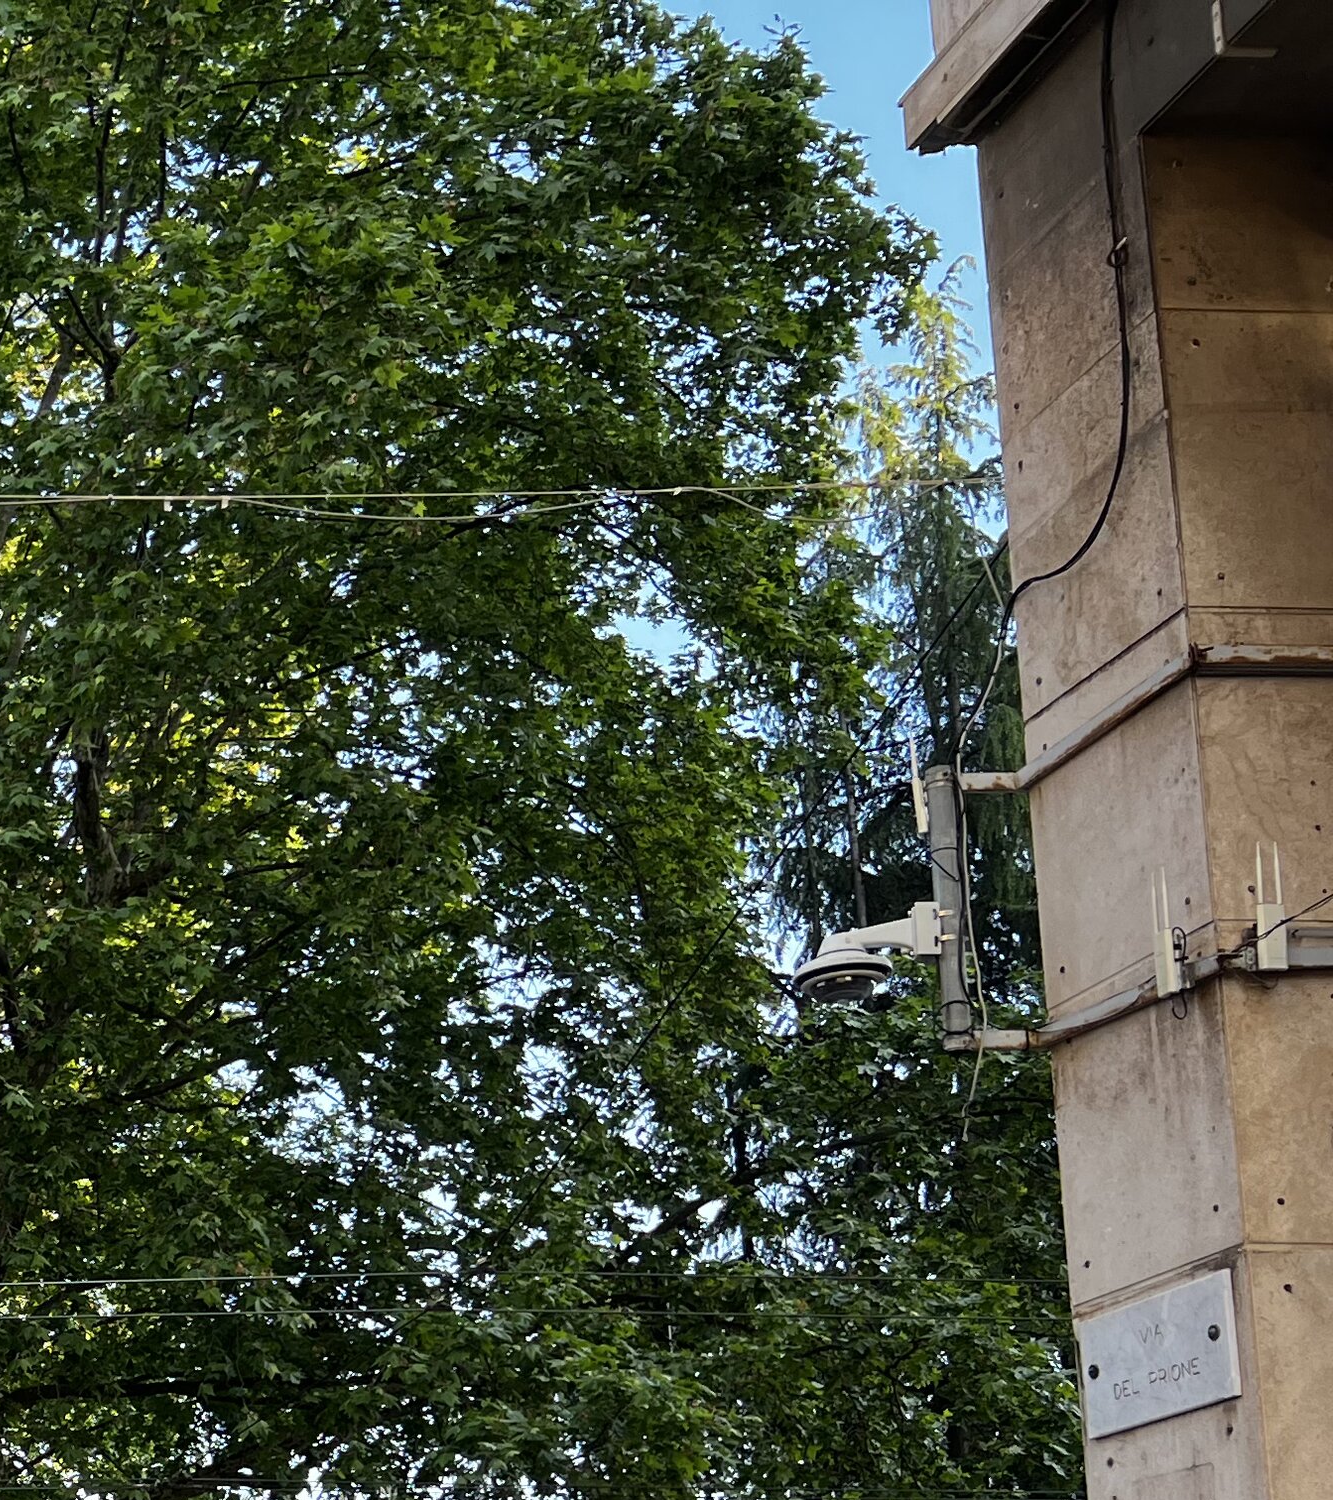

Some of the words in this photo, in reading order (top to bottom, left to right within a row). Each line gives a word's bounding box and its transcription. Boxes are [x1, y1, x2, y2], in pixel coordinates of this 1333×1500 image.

[1138, 1324, 1165, 1344] VIA
[1113, 1379, 1140, 1401] DEL
[1148, 1357, 1201, 1385] PRIONE
